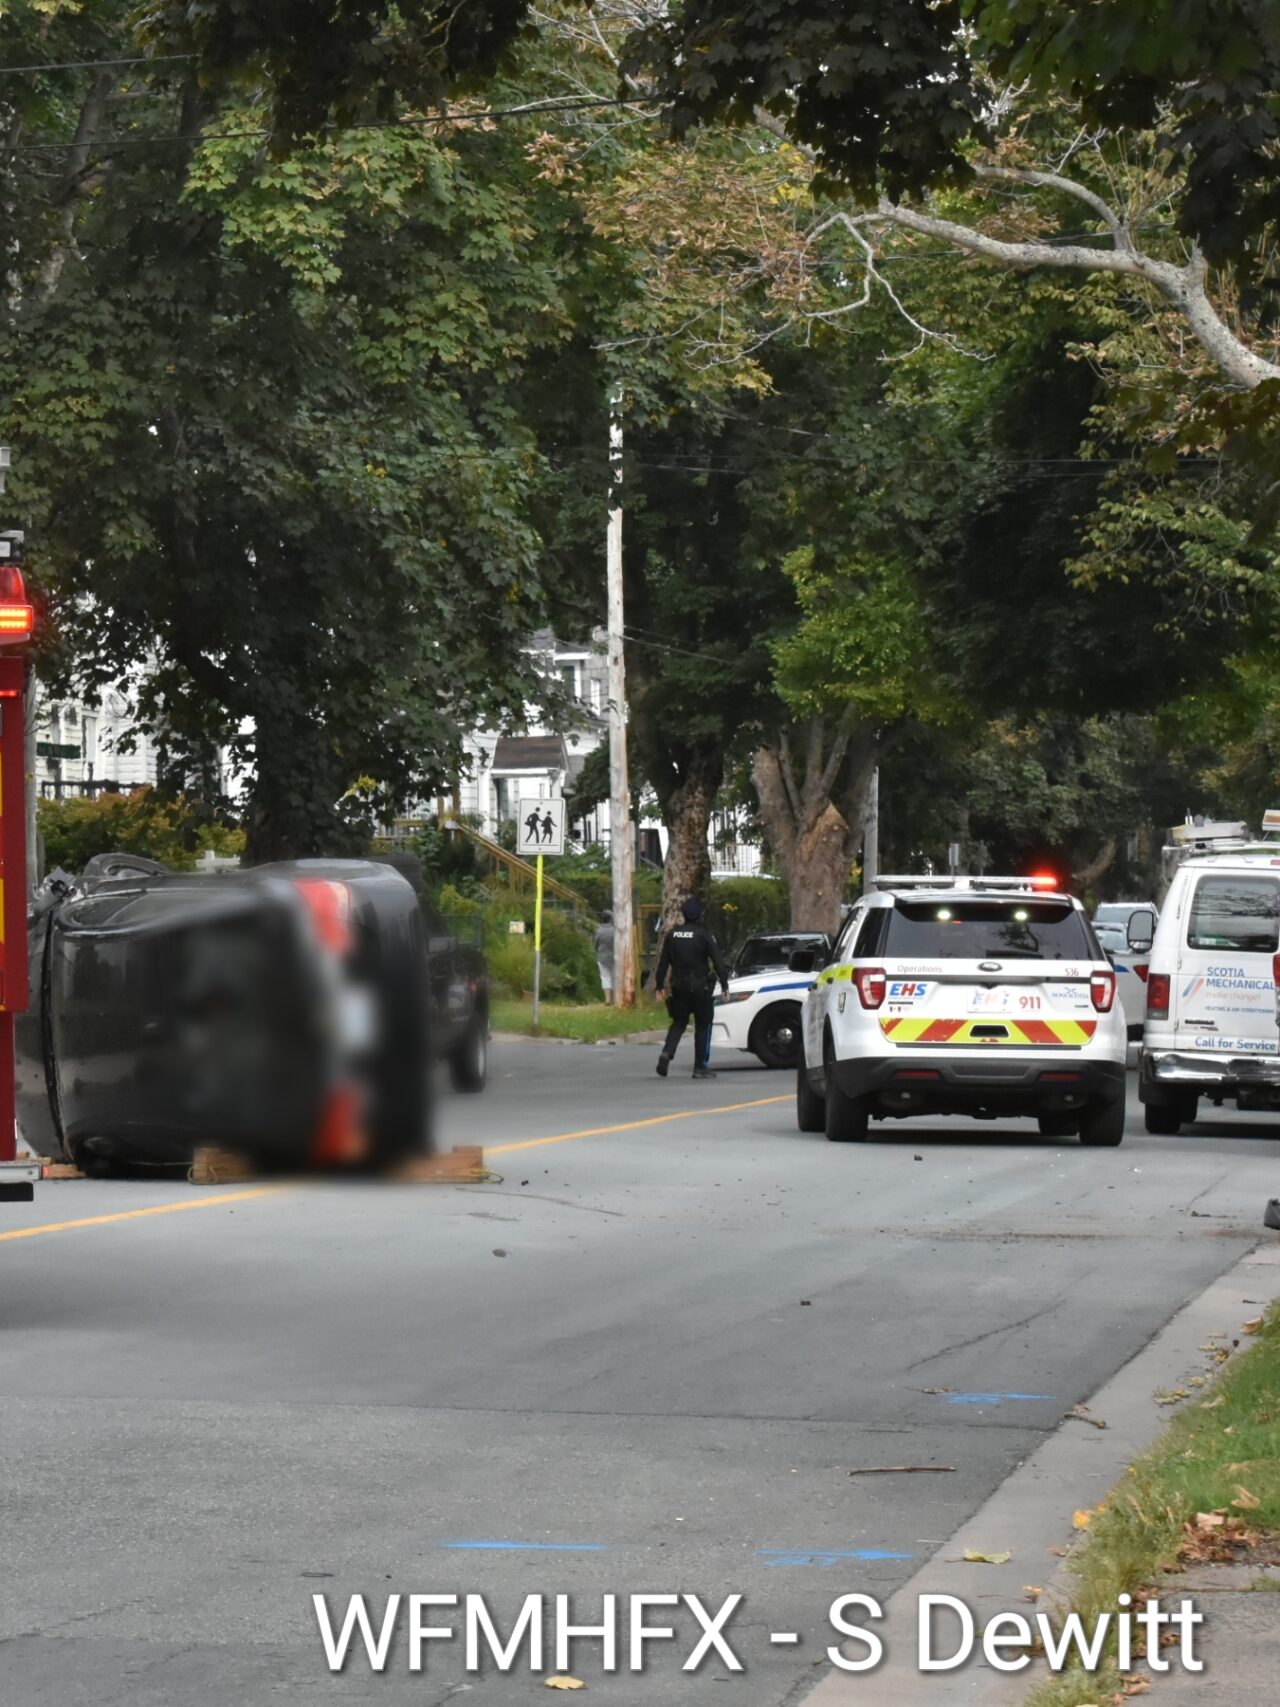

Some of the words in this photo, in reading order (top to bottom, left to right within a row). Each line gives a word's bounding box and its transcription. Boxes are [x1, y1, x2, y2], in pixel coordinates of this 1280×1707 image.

[897, 964, 943, 973] Operations
[1207, 967, 1245, 977] SCOTIA
[889, 983, 928, 996] EHS
[1206, 978, 1275, 990] MECHANICAL
[1019, 996, 1041, 1009] 911
[1195, 1037, 1215, 1048] Call
[1217, 1038, 1233, 1048] for
[1236, 1039, 1276, 1050] Service
